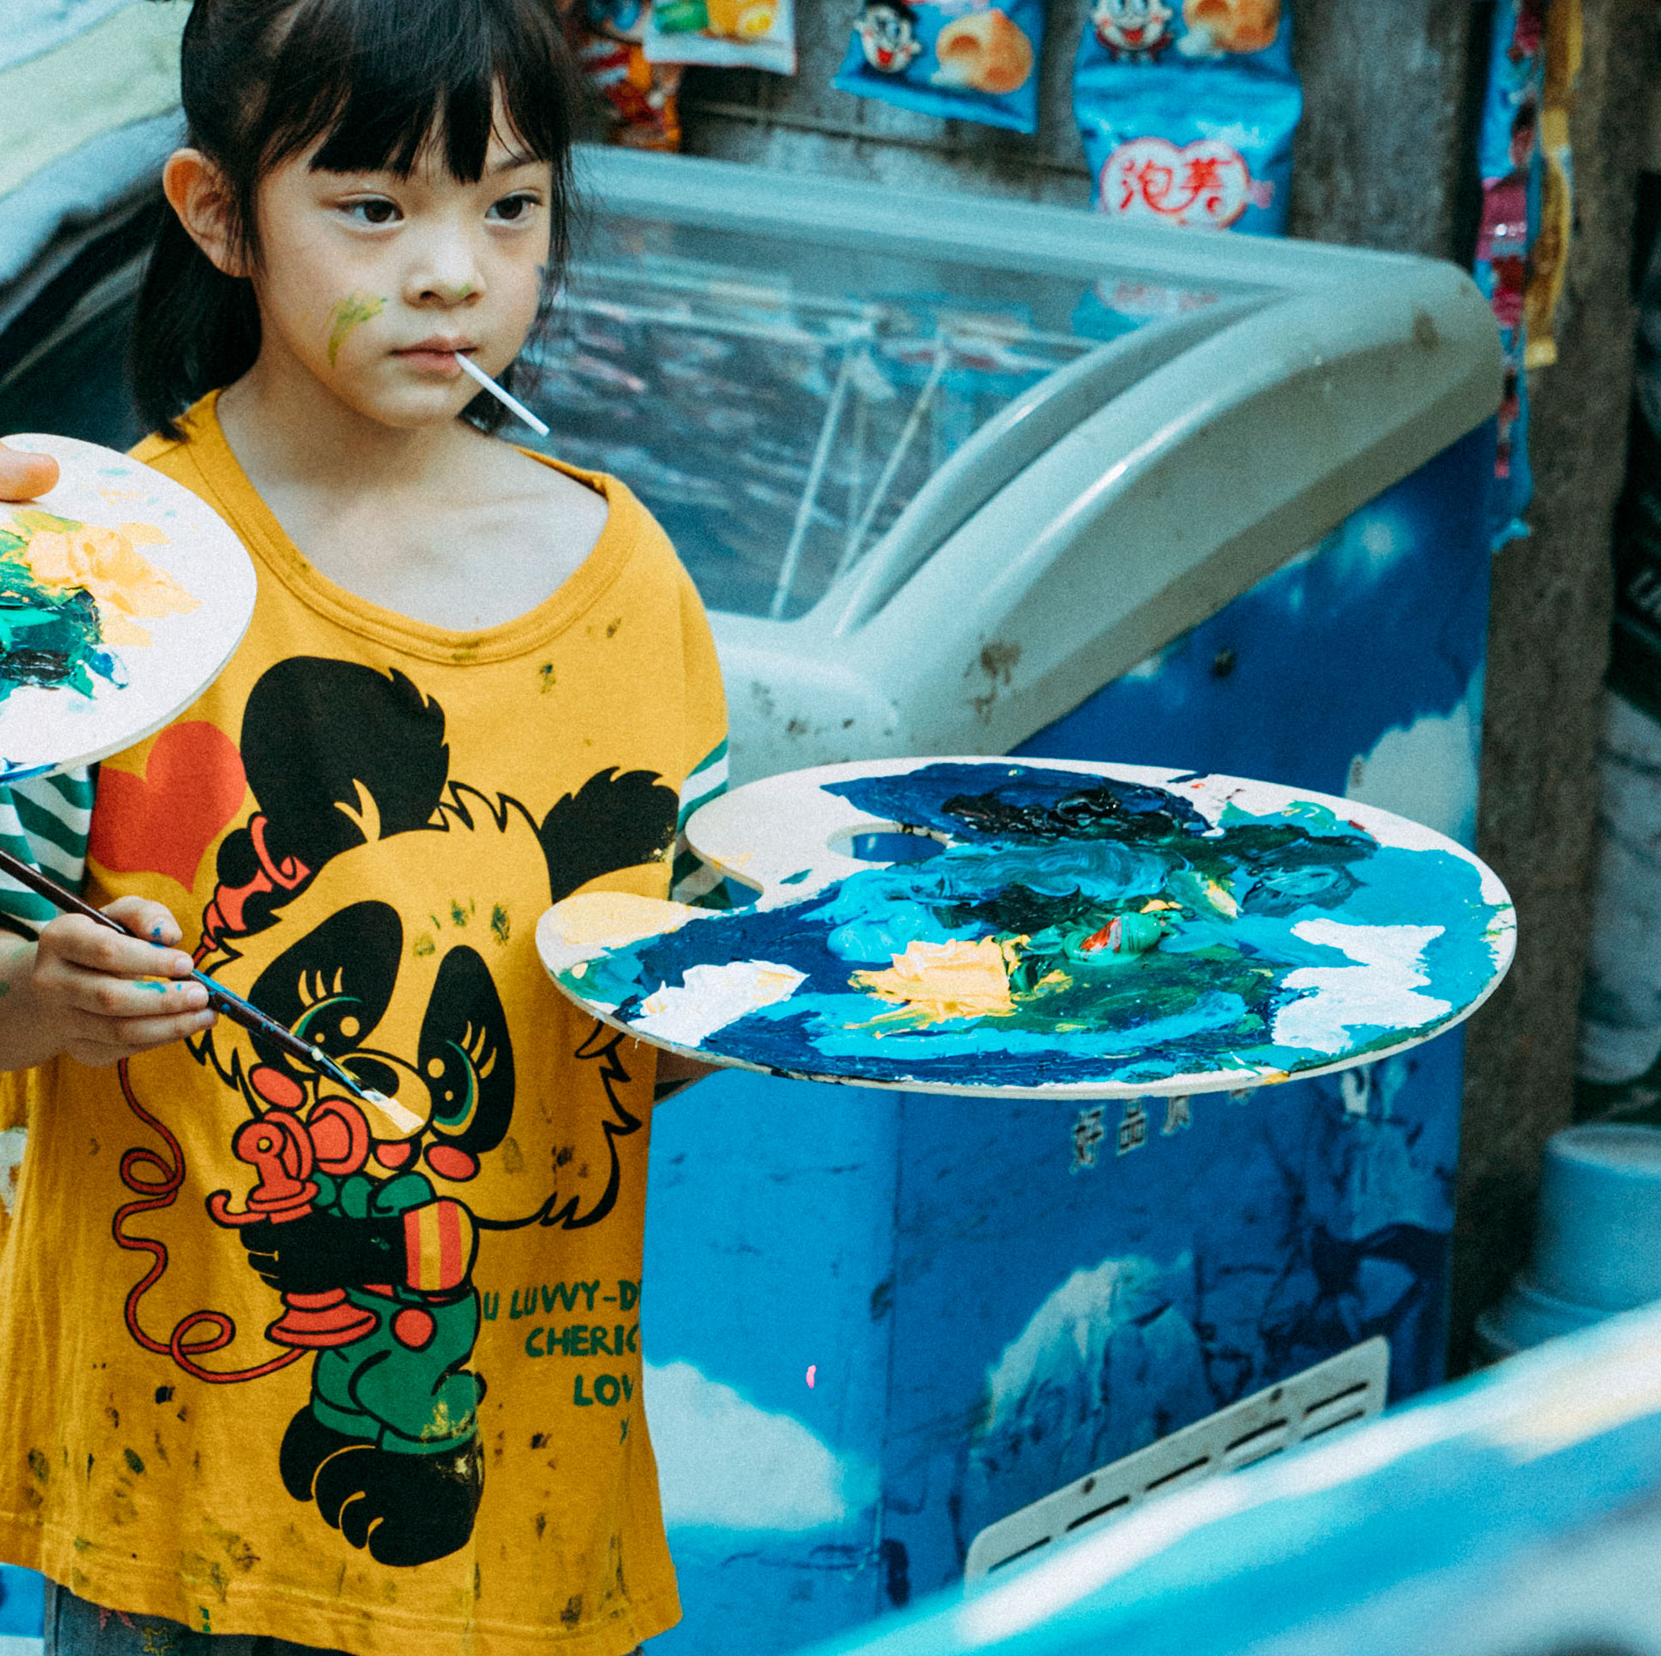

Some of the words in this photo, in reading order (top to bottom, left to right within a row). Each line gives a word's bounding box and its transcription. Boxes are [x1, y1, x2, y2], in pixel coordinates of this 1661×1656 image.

[1118, 156, 1235, 215] 泡芙
[483, 1291, 500, 1321] U
[509, 1279, 641, 1320] LUVVY-D
